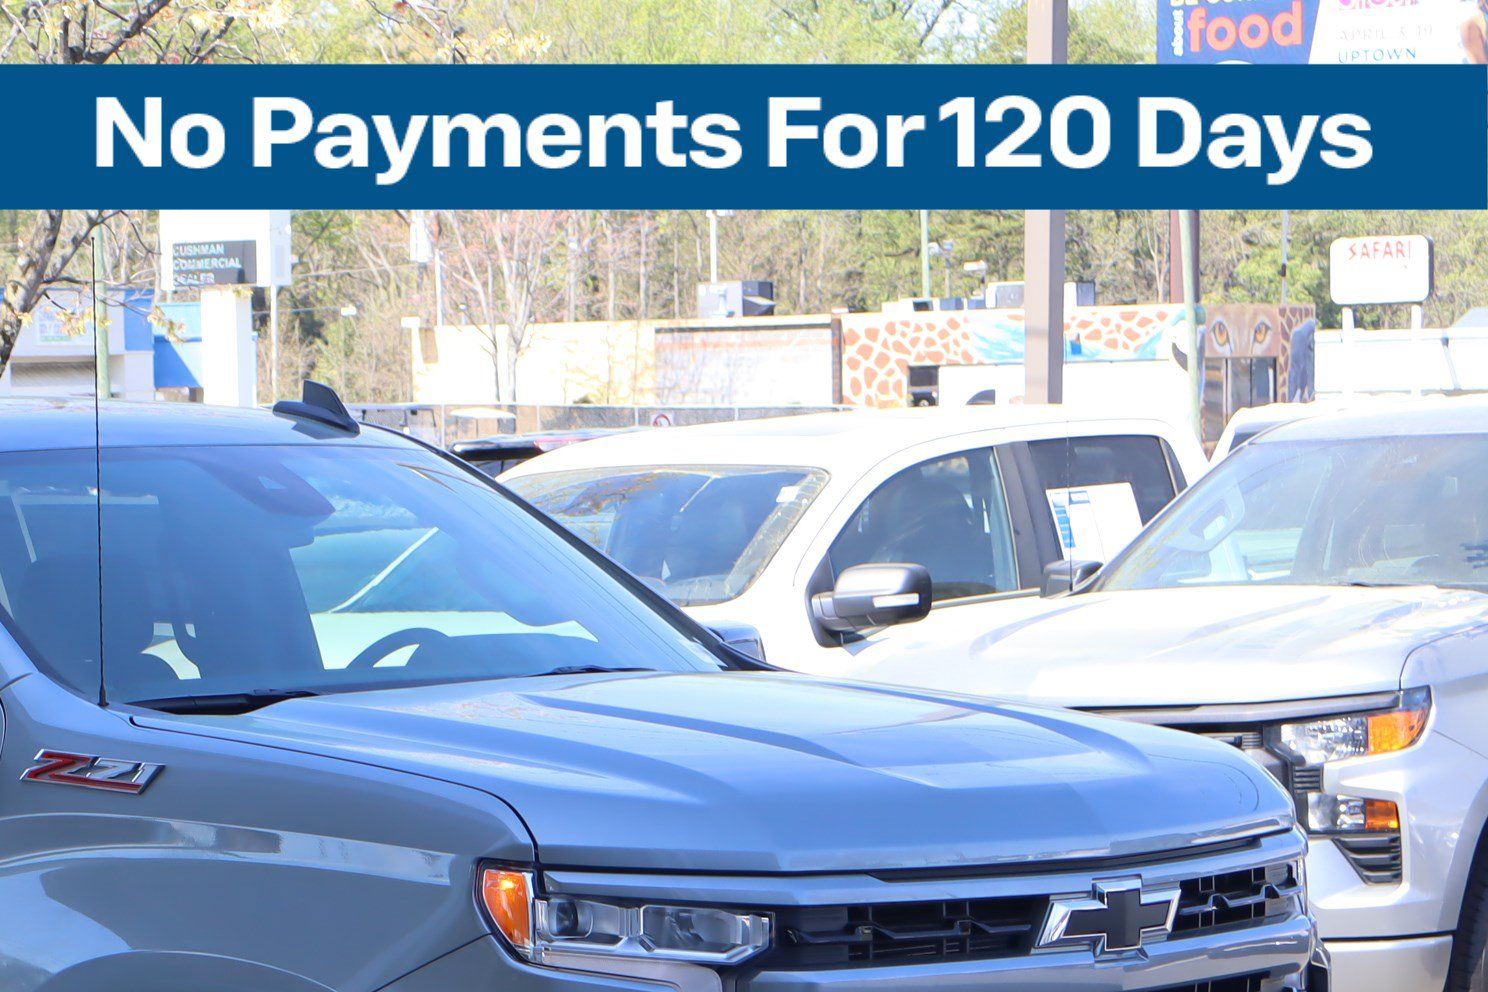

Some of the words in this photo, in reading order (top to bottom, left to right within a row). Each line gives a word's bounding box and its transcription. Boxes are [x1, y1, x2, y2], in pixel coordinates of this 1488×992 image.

[1187, 0, 1304, 53] food
[1338, 47, 1418, 64] UPTOWN
[173, 243, 225, 257] CUSHMAN
[1348, 240, 1411, 261] SAFARI
[173, 257, 242, 272] COMMERCIAL
[19, 748, 167, 796] Z71
